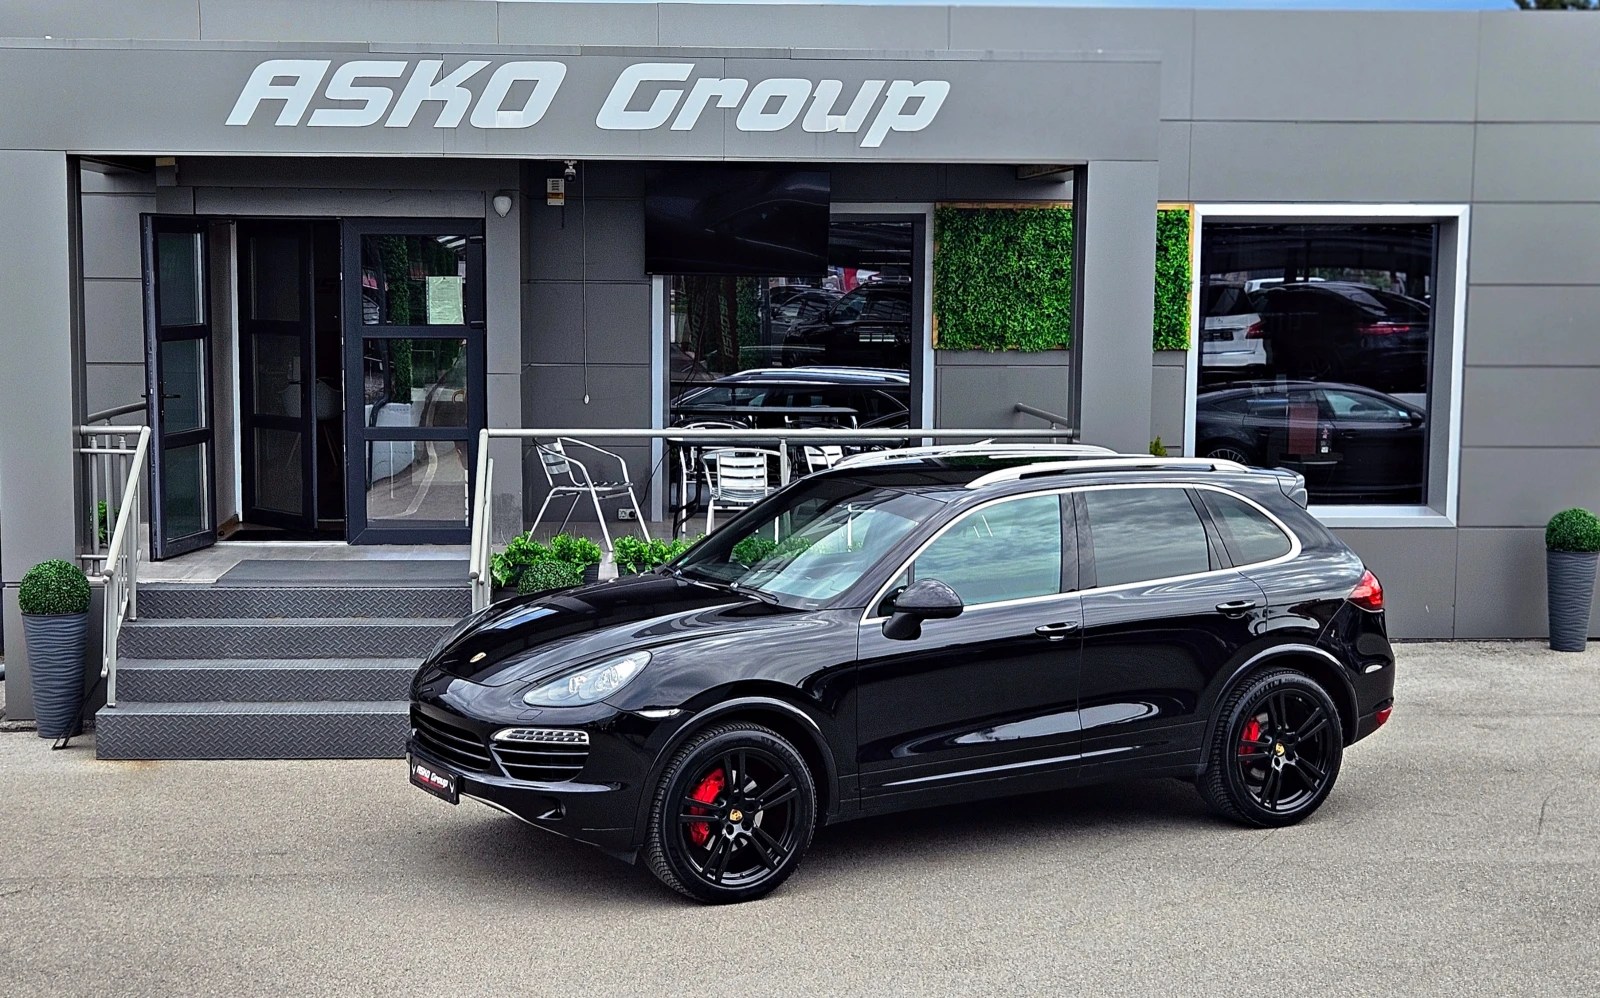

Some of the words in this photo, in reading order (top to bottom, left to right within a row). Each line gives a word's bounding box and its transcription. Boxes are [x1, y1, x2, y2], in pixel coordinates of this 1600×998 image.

[225, 60, 566, 128] ASKO
[596, 63, 950, 148] Group
[417, 765, 430, 778] ASKO
[431, 772, 448, 788] Group
